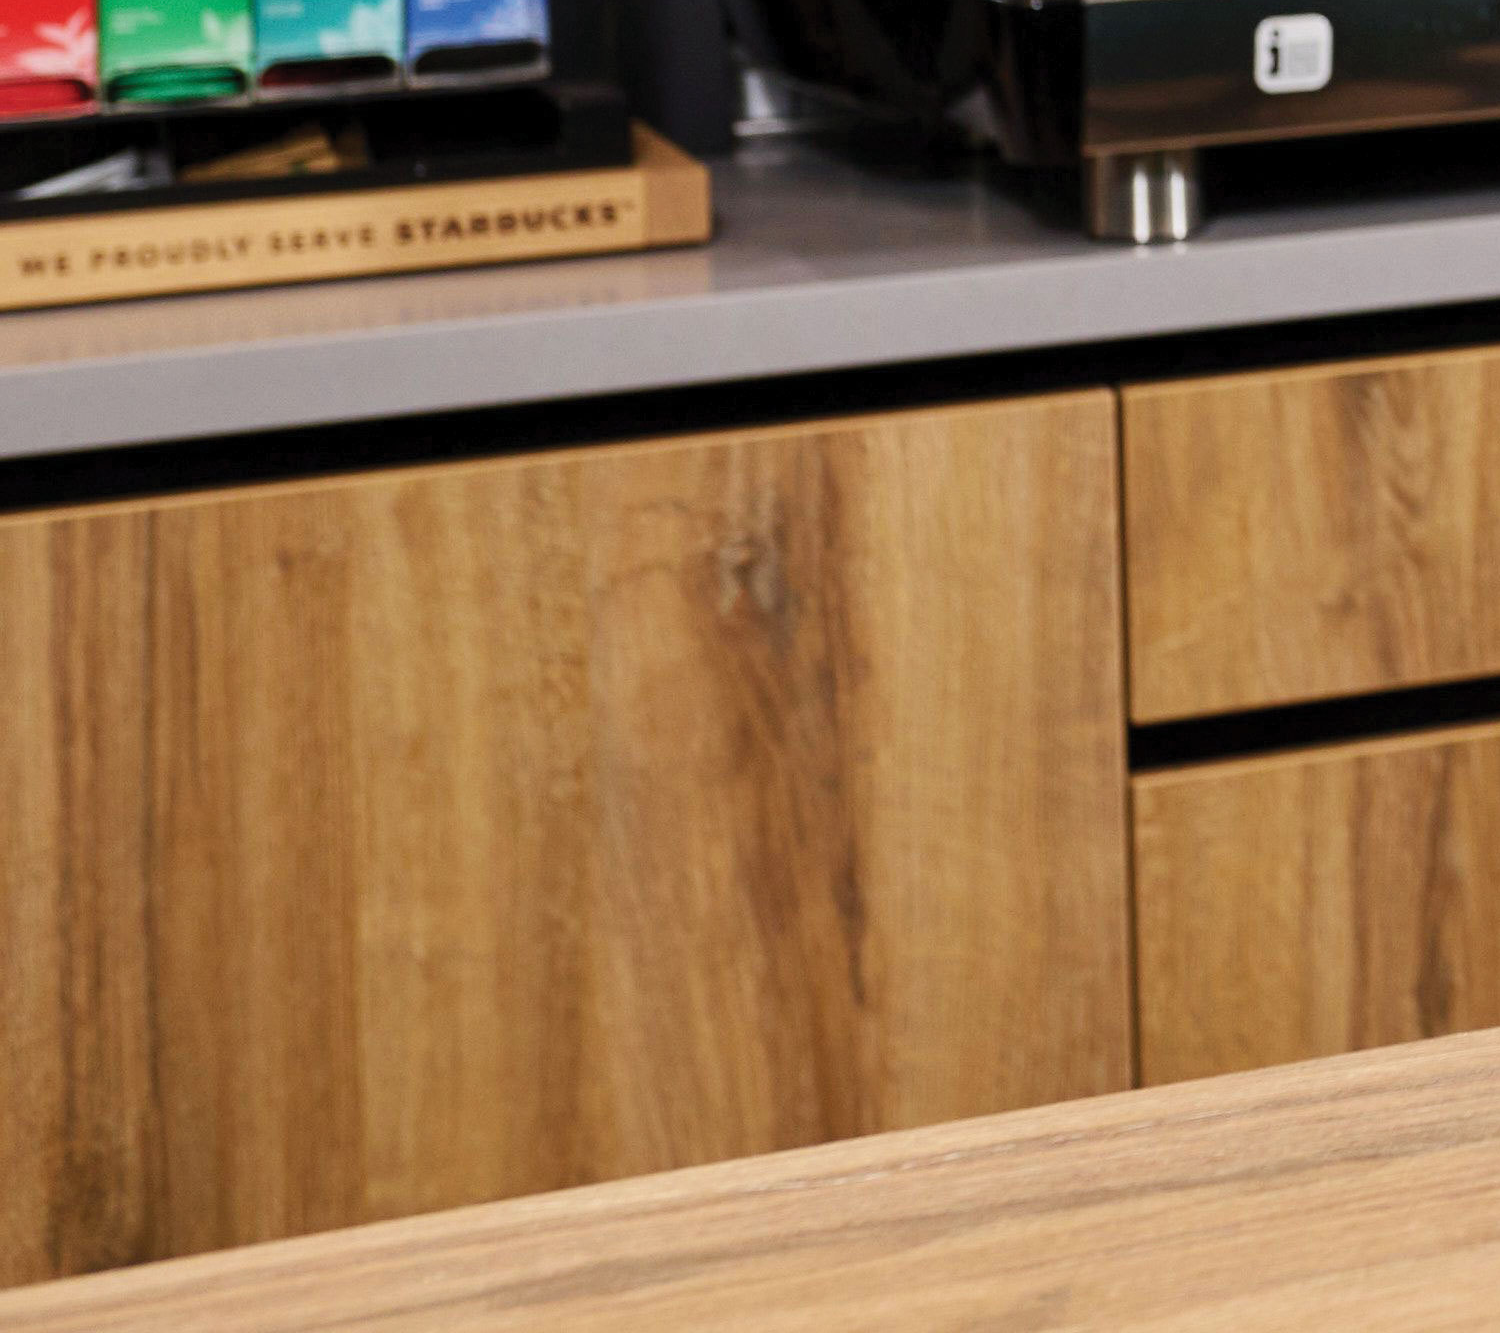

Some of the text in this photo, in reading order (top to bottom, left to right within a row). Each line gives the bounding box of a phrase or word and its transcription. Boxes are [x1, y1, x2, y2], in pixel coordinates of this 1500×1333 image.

[19, 254, 71, 278] WE
[90, 235, 251, 273] PROUDLY
[269, 225, 377, 257] SERVE
